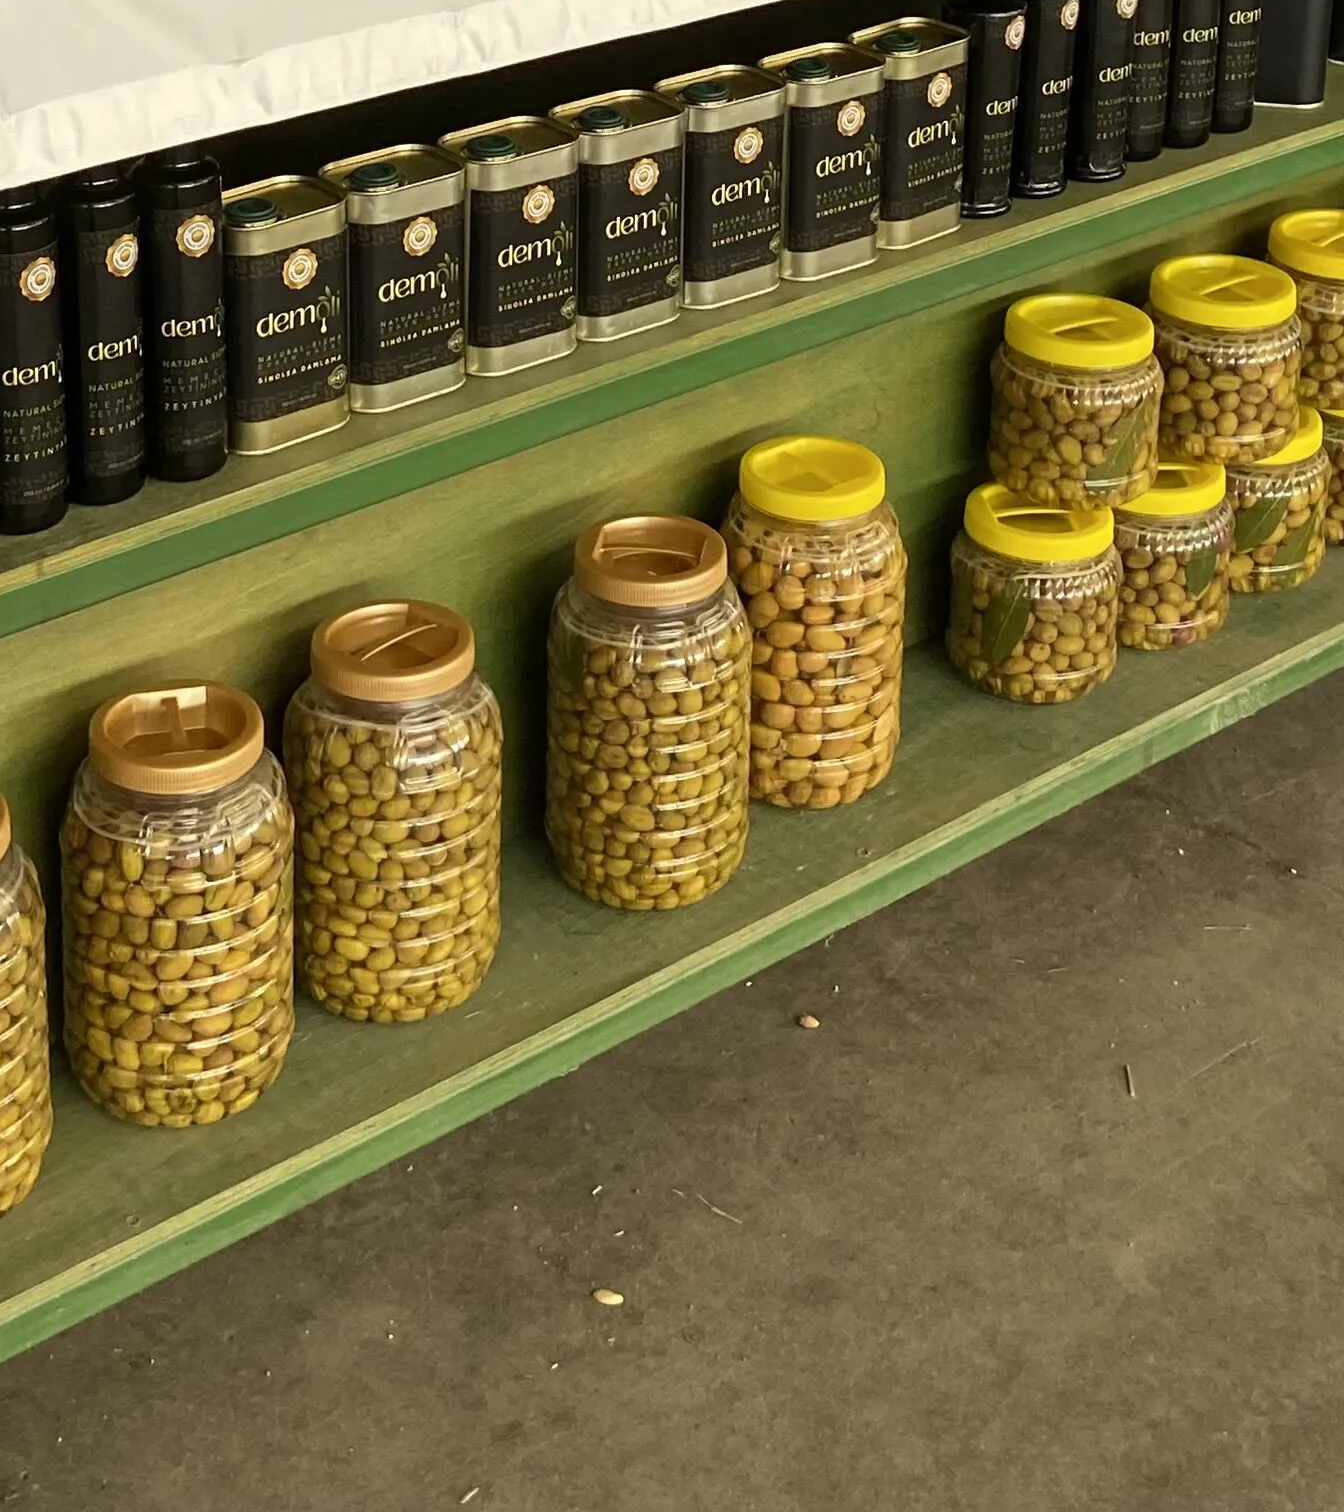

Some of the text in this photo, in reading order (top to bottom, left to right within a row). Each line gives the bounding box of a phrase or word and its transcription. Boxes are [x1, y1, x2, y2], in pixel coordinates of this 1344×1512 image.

[605, 197, 678, 239] demoli
[497, 225, 573, 268] demoli
[378, 256, 459, 303] demoli
[161, 315, 215, 337] dem
[256, 290, 341, 338] demoli
[87, 334, 140, 361] dem
[2, 360, 56, 387] dem
